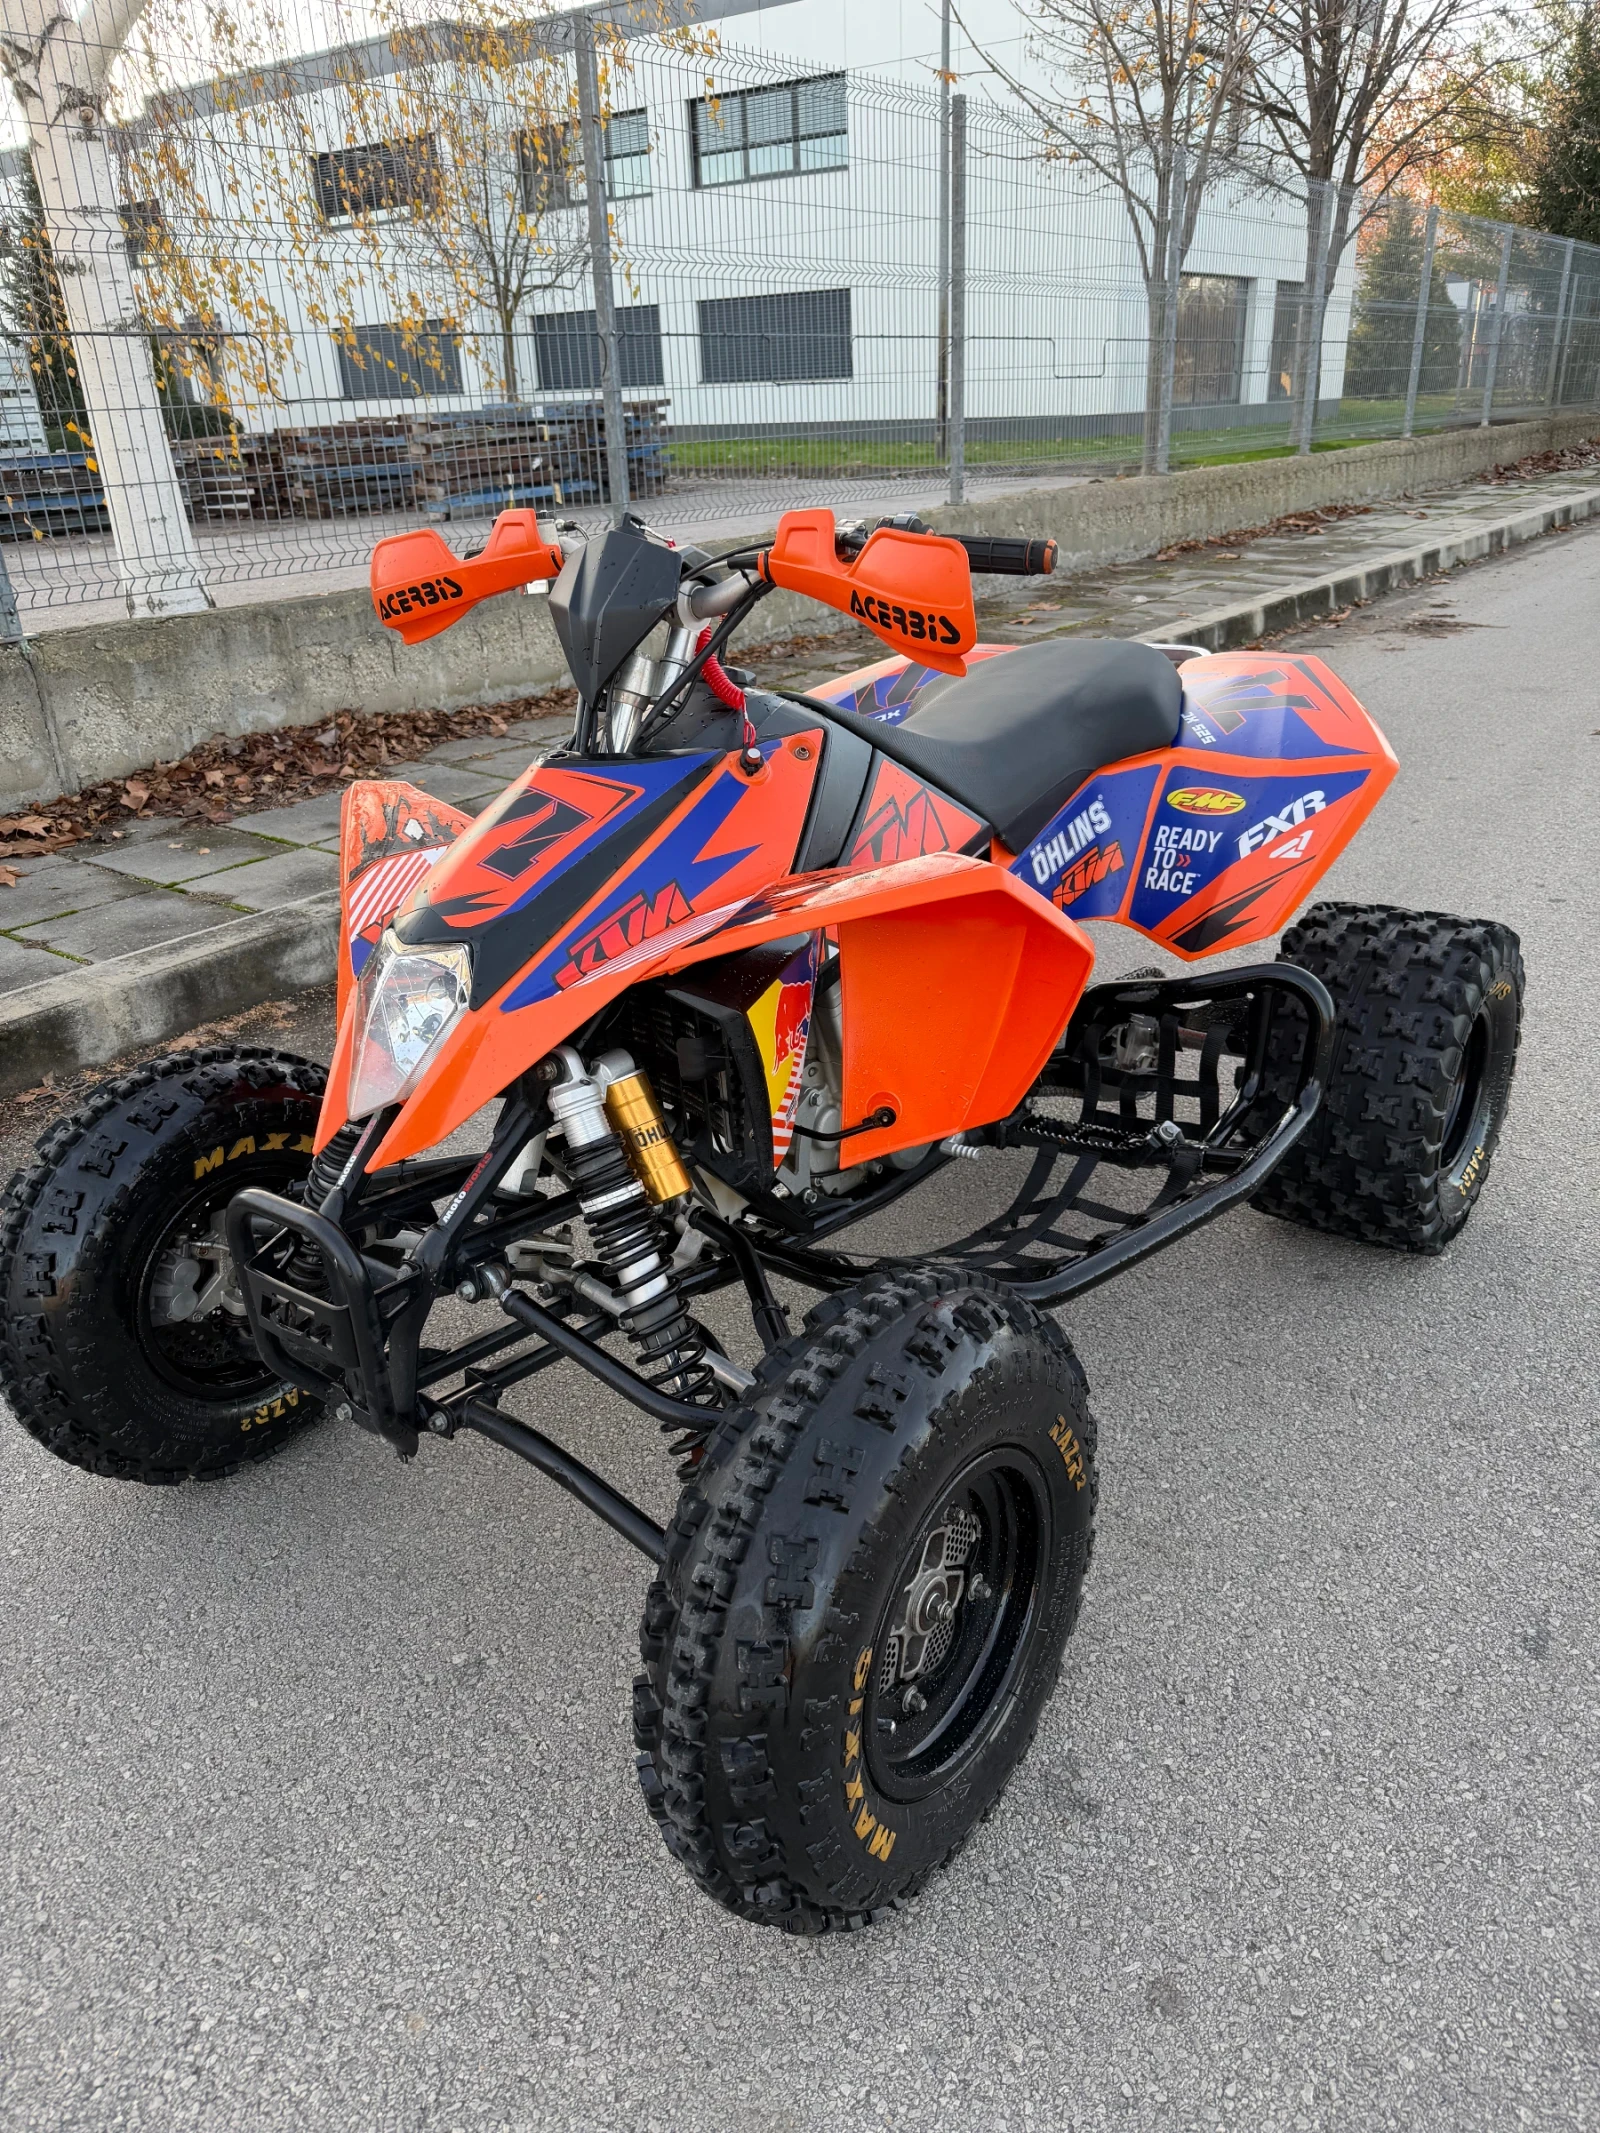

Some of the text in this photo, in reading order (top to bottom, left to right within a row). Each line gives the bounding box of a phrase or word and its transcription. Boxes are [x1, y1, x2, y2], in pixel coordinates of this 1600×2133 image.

[850, 589, 961, 645] ACERBIS
[1191, 723, 1217, 745] 525
[851, 787, 951, 864] TM
[1169, 791, 1246, 811] FMF
[1234, 790, 1327, 860] FXR
[1030, 800, 1112, 885] ÖHLINS
[1152, 846, 1177, 869] TO
[1155, 825, 1224, 853] READY
[1051, 840, 1125, 913] KTM
[1144, 867, 1197, 895] RACE
[551, 878, 696, 992] KTM
[193, 1132, 316, 1181] MAXX
[633, 1122, 670, 1148] ÖHL
[844, 1645, 898, 1862] MAXXIS
